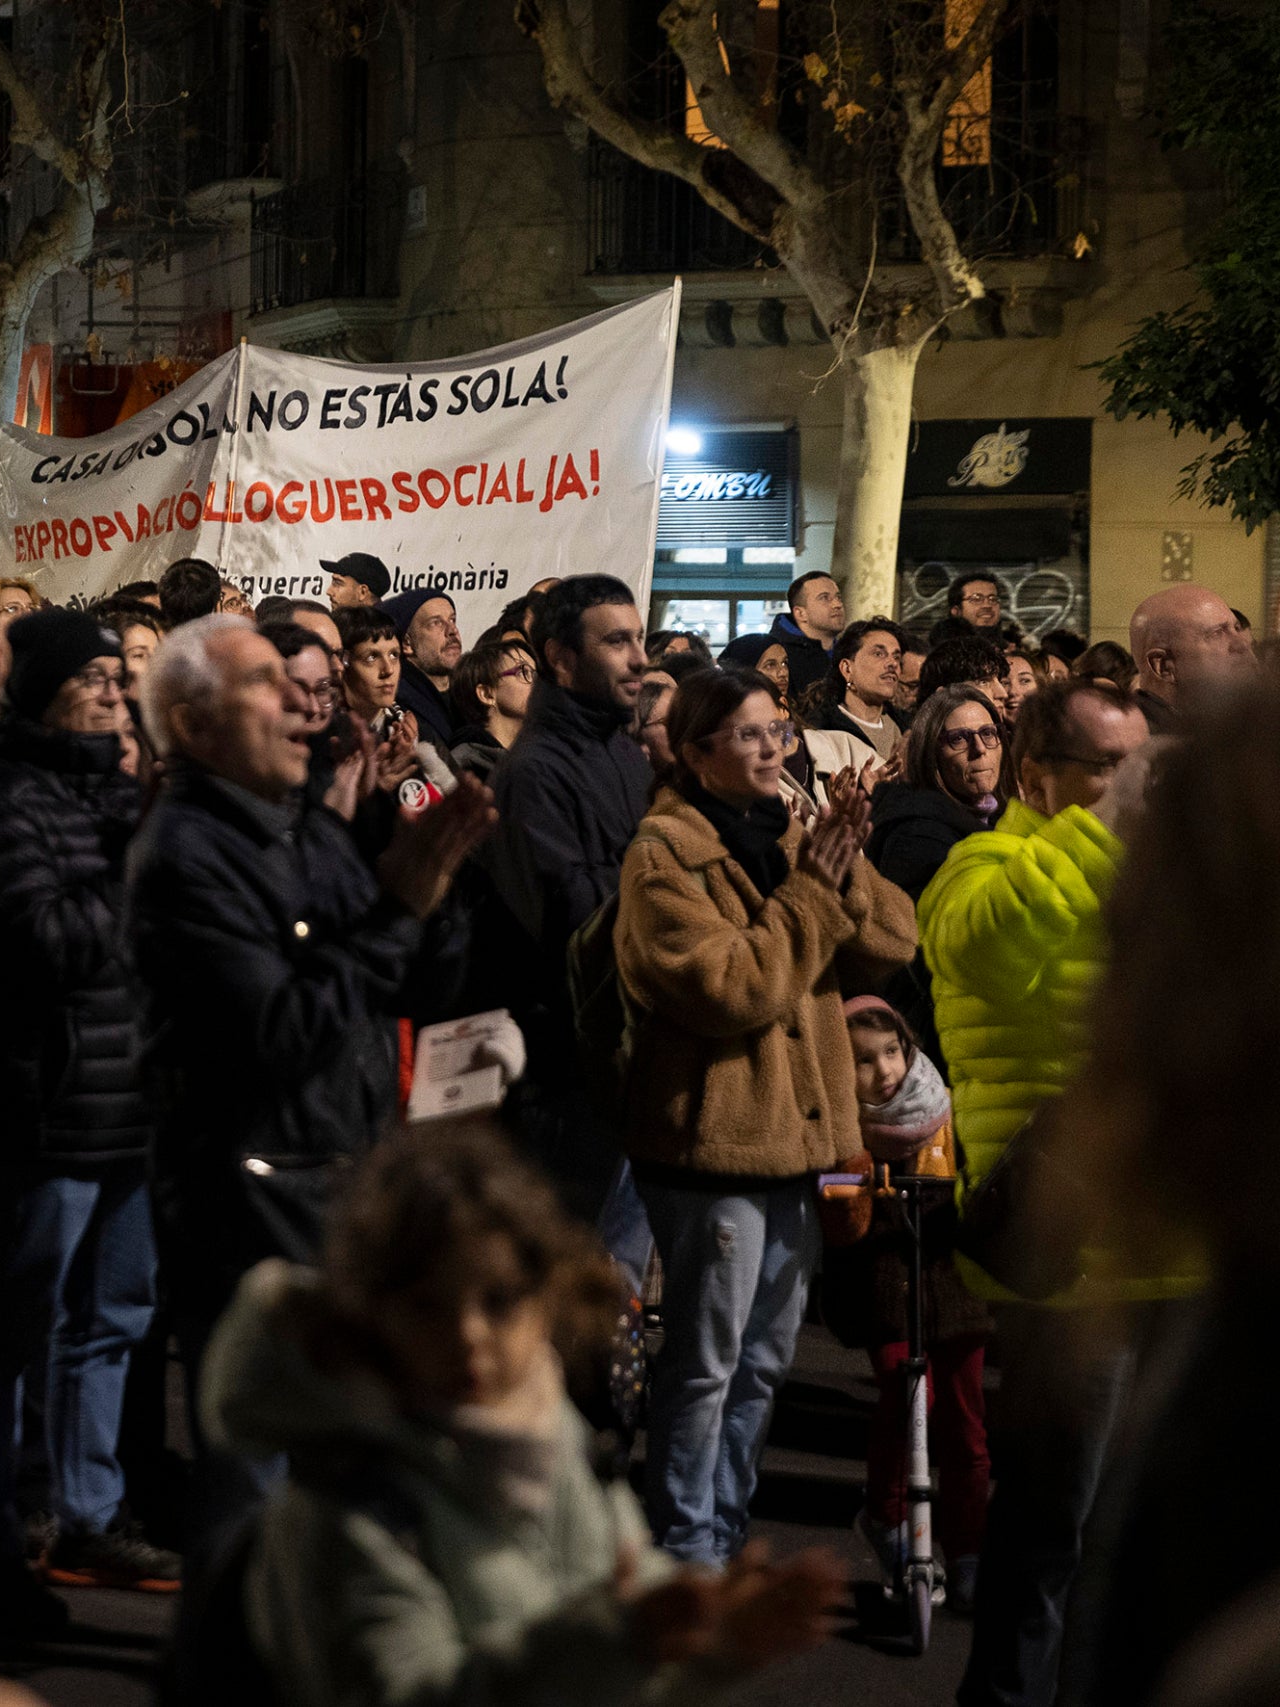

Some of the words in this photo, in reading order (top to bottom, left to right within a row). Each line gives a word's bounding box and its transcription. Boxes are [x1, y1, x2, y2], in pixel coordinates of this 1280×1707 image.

[31, 448, 113, 484] CASA
[112, 402, 236, 471] OSOL
[246, 389, 310, 433] NO
[319, 372, 440, 430] ESTÀS
[446, 355, 569, 416] SOLA!
[14, 479, 202, 563] EXPROPIACIÓ
[201, 477, 393, 525] LLOGUER
[391, 458, 535, 513] SOCIAL
[538, 448, 600, 513] JA!
[218, 567, 324, 598] querra
[391, 561, 509, 593] lucionària
